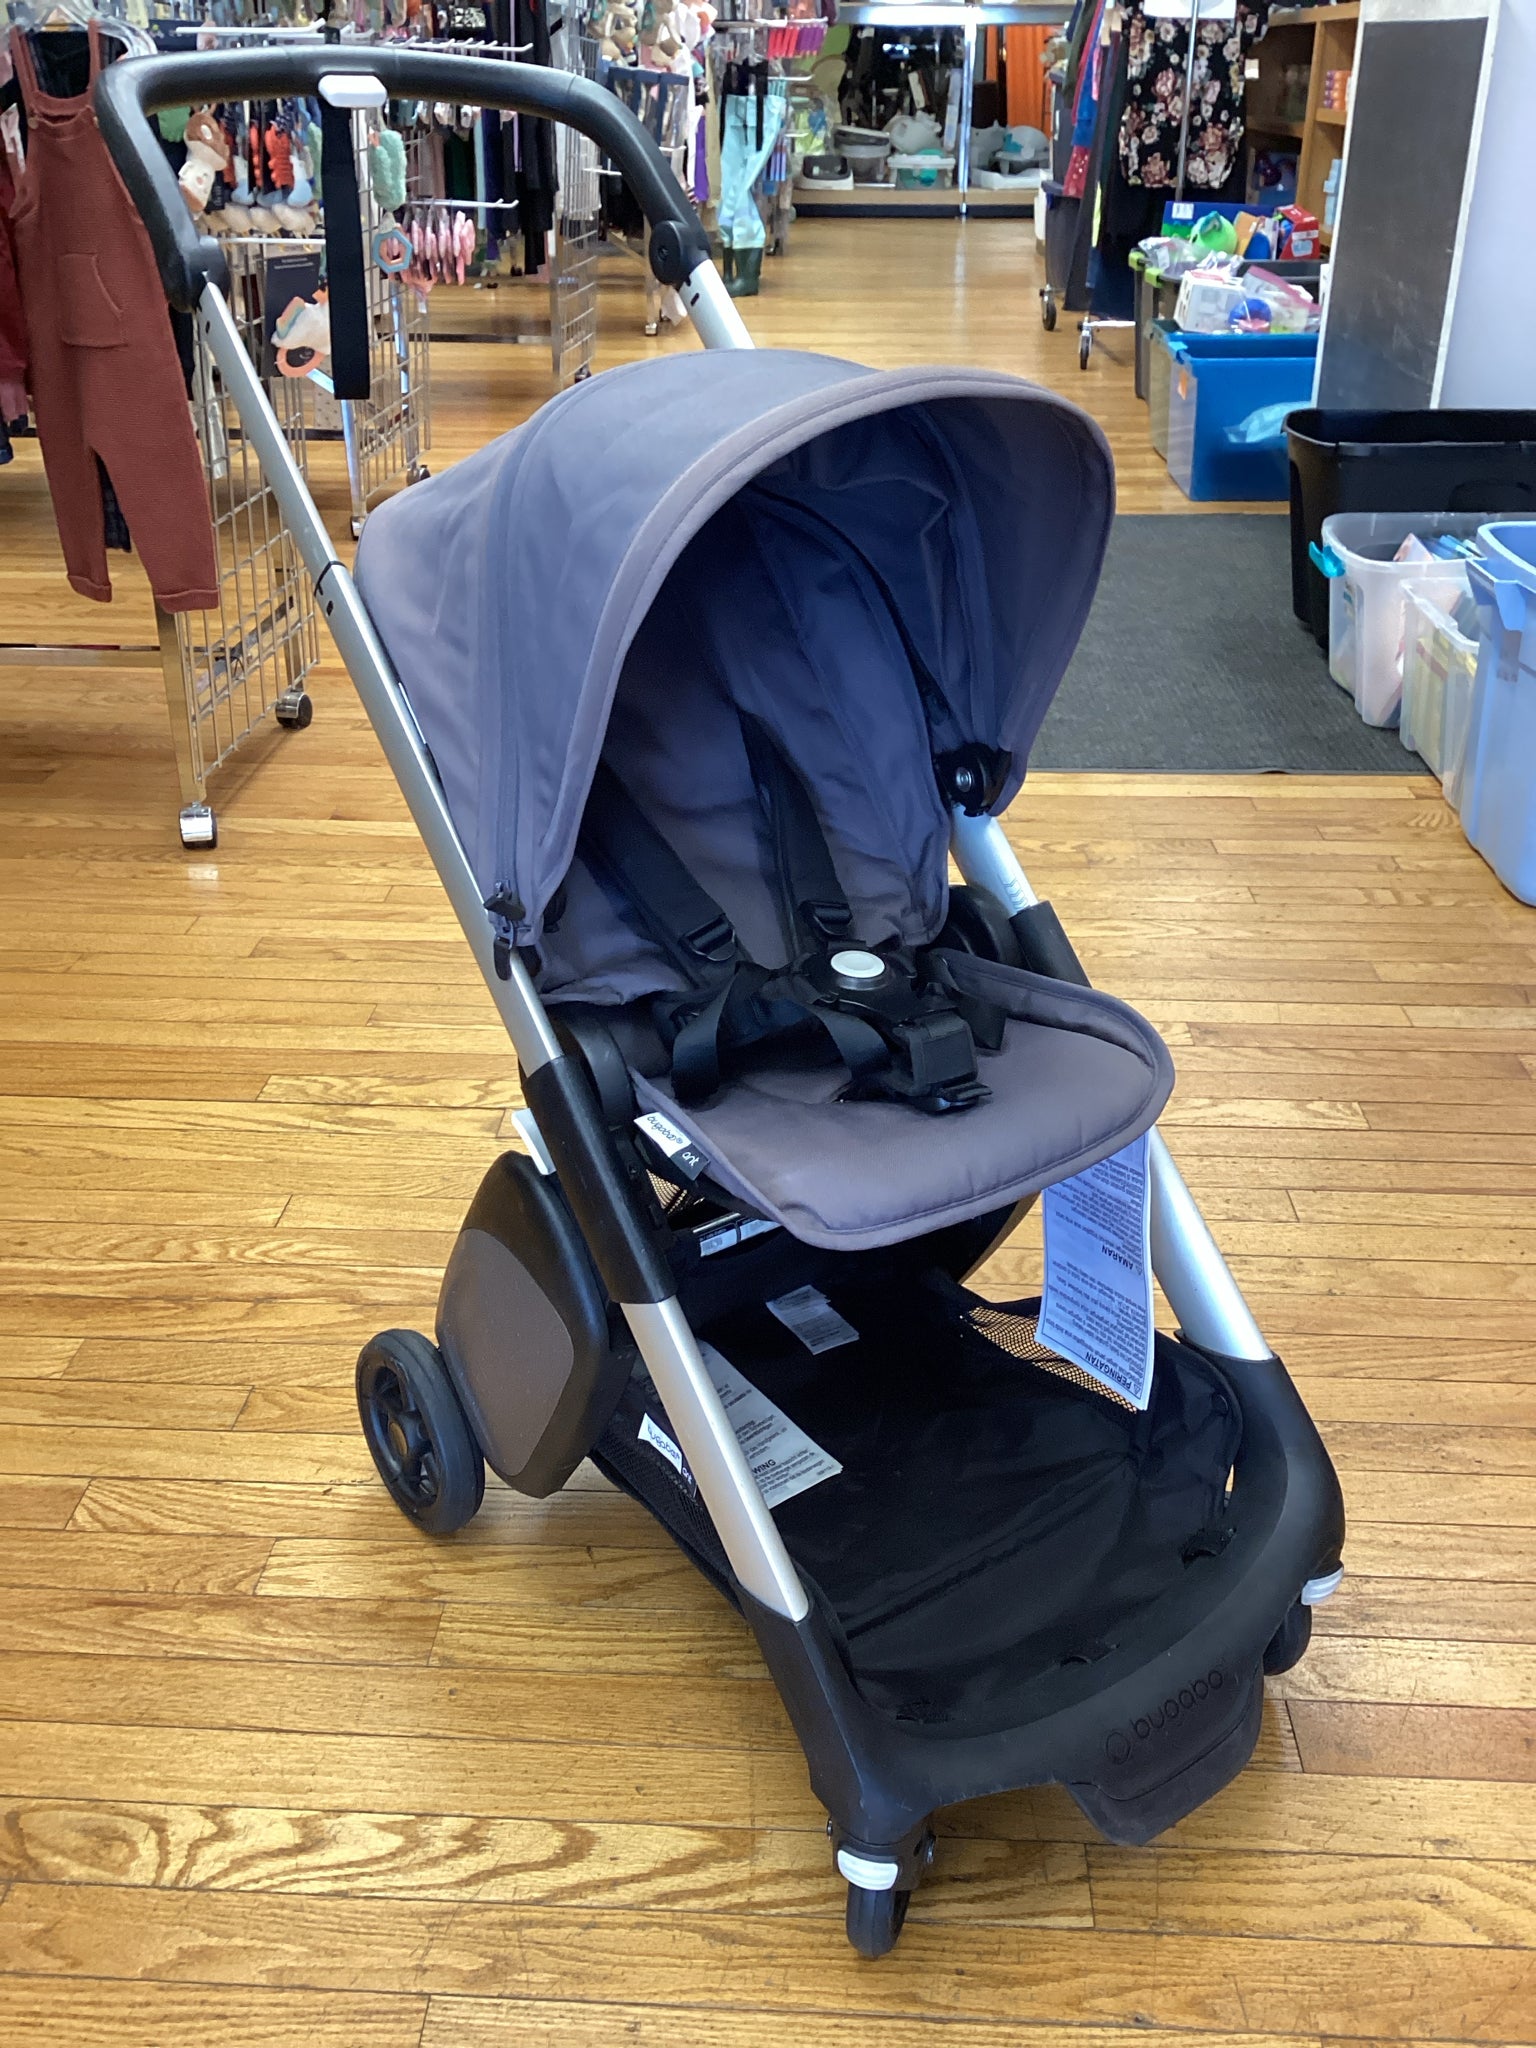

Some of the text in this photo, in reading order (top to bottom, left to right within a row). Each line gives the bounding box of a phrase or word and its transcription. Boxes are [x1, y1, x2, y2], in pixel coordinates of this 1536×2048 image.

[682, 1151, 699, 1167] ant
[1101, 1244, 1134, 1270] AMARAN
[1084, 1351, 1132, 1389] PERINGATAN
